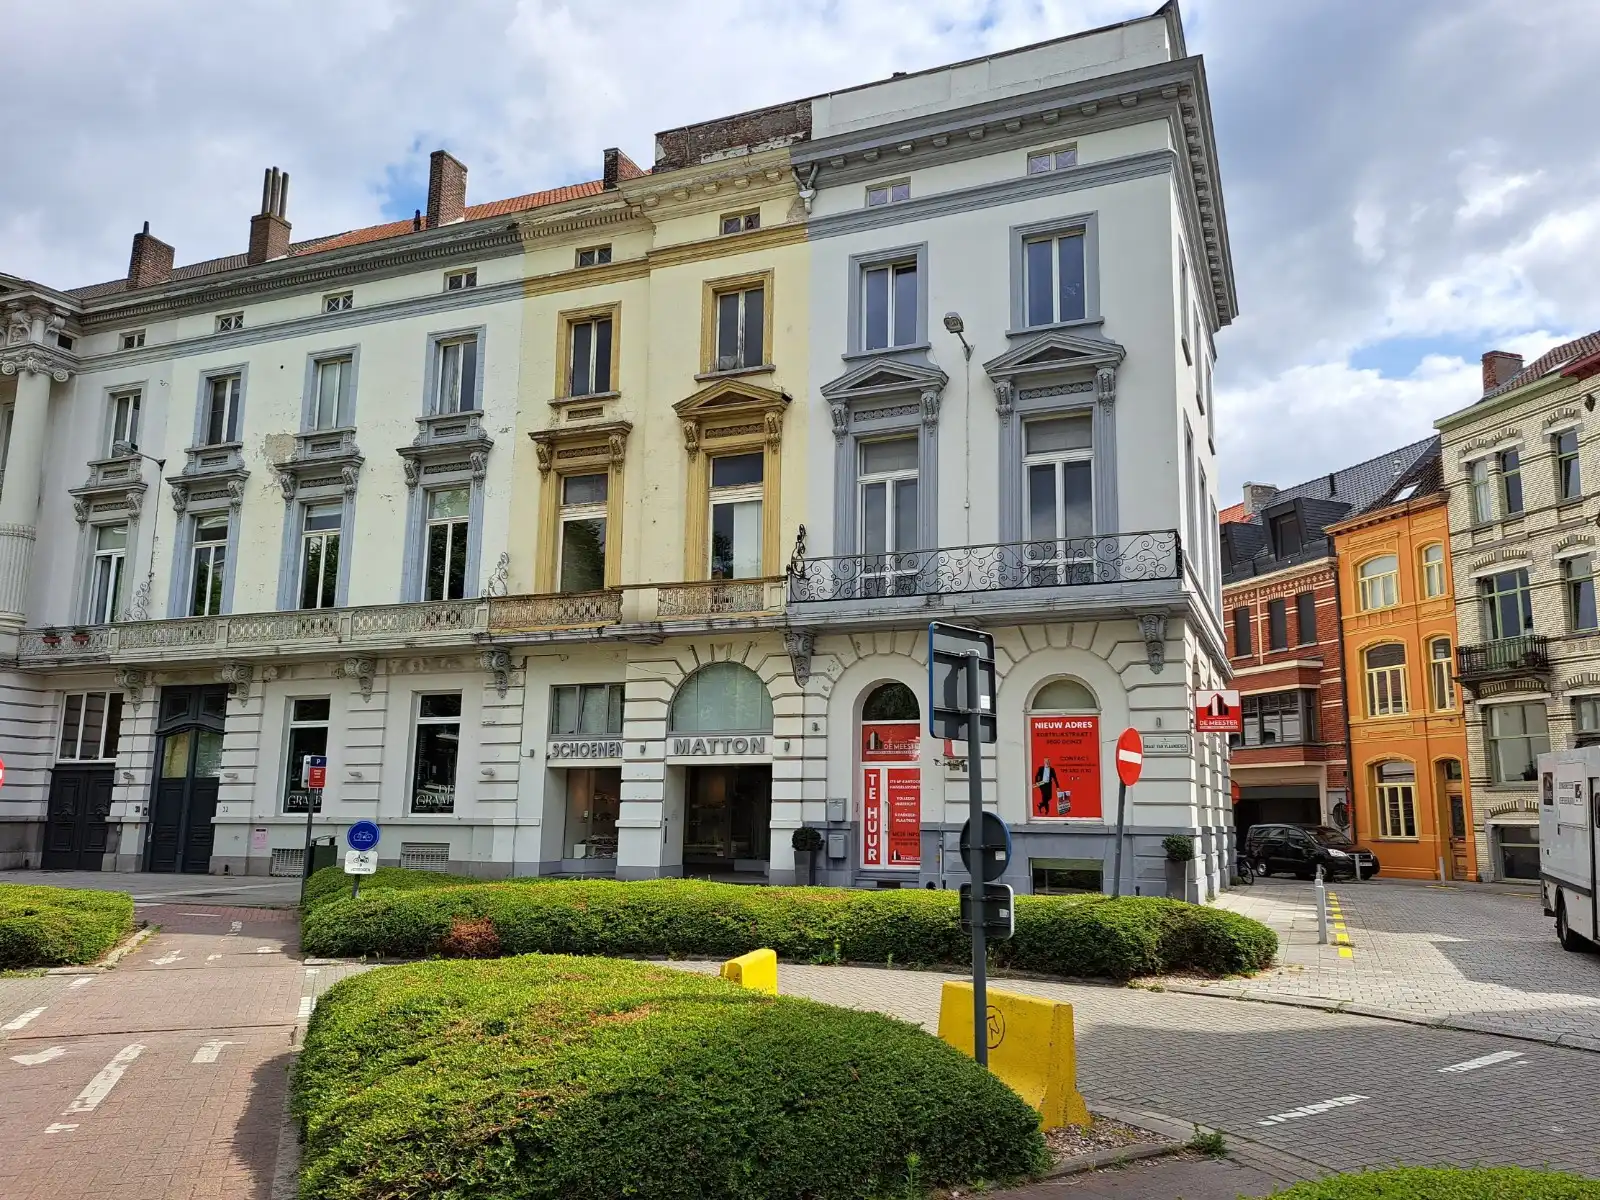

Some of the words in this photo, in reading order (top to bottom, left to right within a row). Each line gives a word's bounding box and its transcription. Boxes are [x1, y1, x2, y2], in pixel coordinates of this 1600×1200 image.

[1034, 721, 1063, 729] NIEUW
[1064, 721, 1093, 729] ADRES
[552, 741, 623, 758] SCHOENEN
[673, 736, 766, 755] MATTON
[868, 773, 878, 800] TE
[287, 794, 322, 805] GRAF
[416, 794, 454, 805] GRAAF
[867, 807, 878, 861] HUUR
